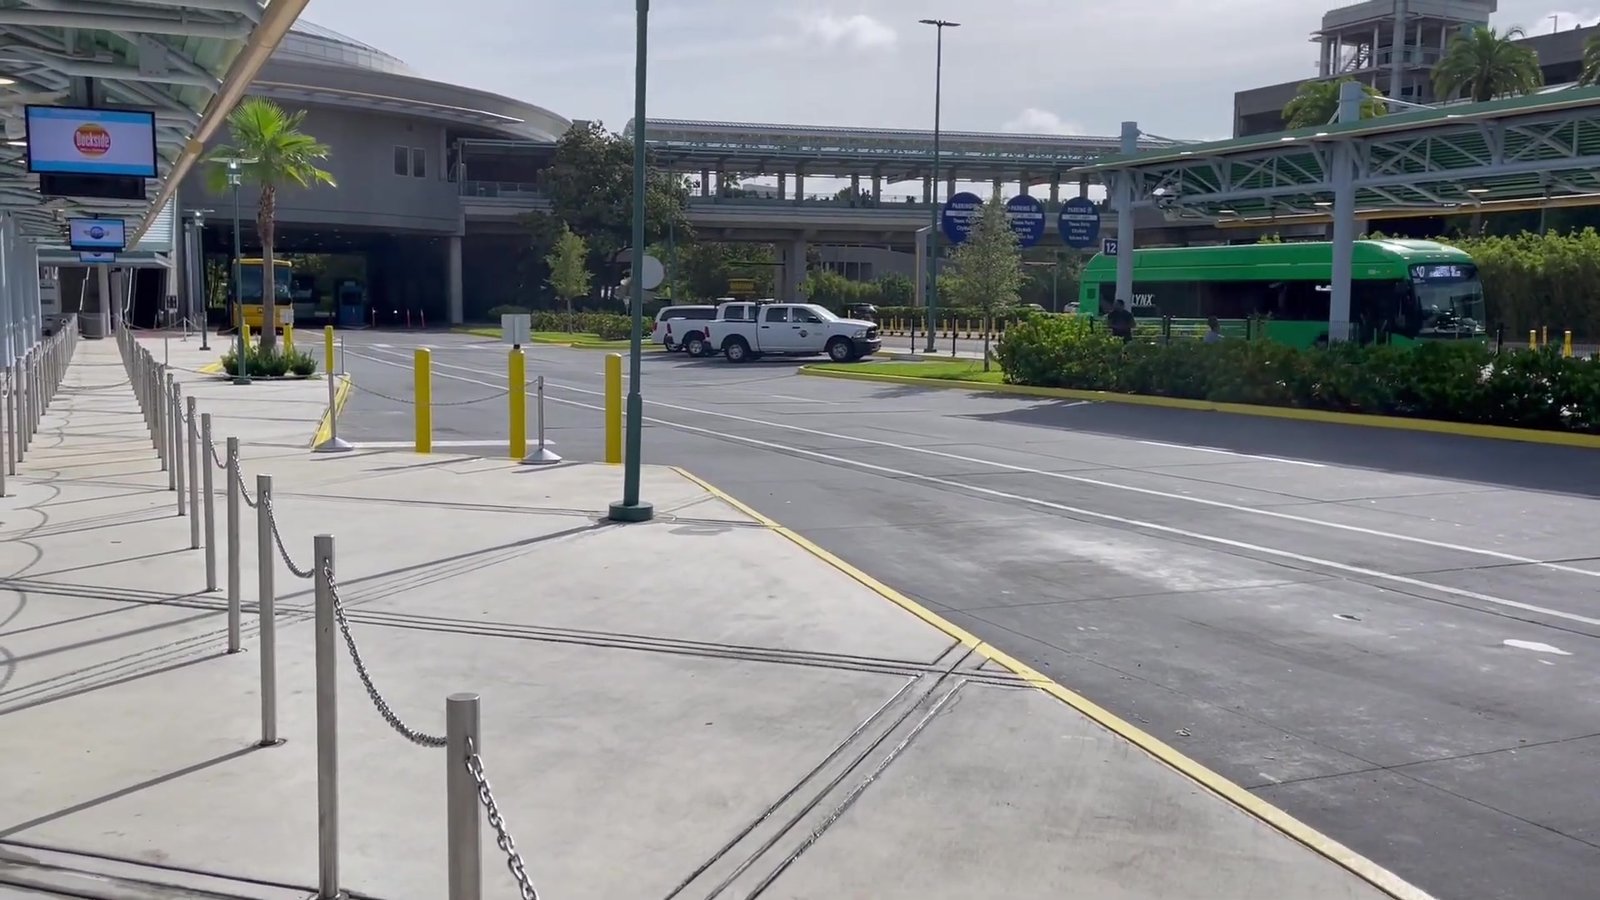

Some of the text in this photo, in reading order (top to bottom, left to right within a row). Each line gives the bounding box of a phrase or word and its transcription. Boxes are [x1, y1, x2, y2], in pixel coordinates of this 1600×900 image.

[76, 131, 109, 148] Dockside
[1106, 243, 1117, 253] 12
[1132, 294, 1153, 306] LYNX
